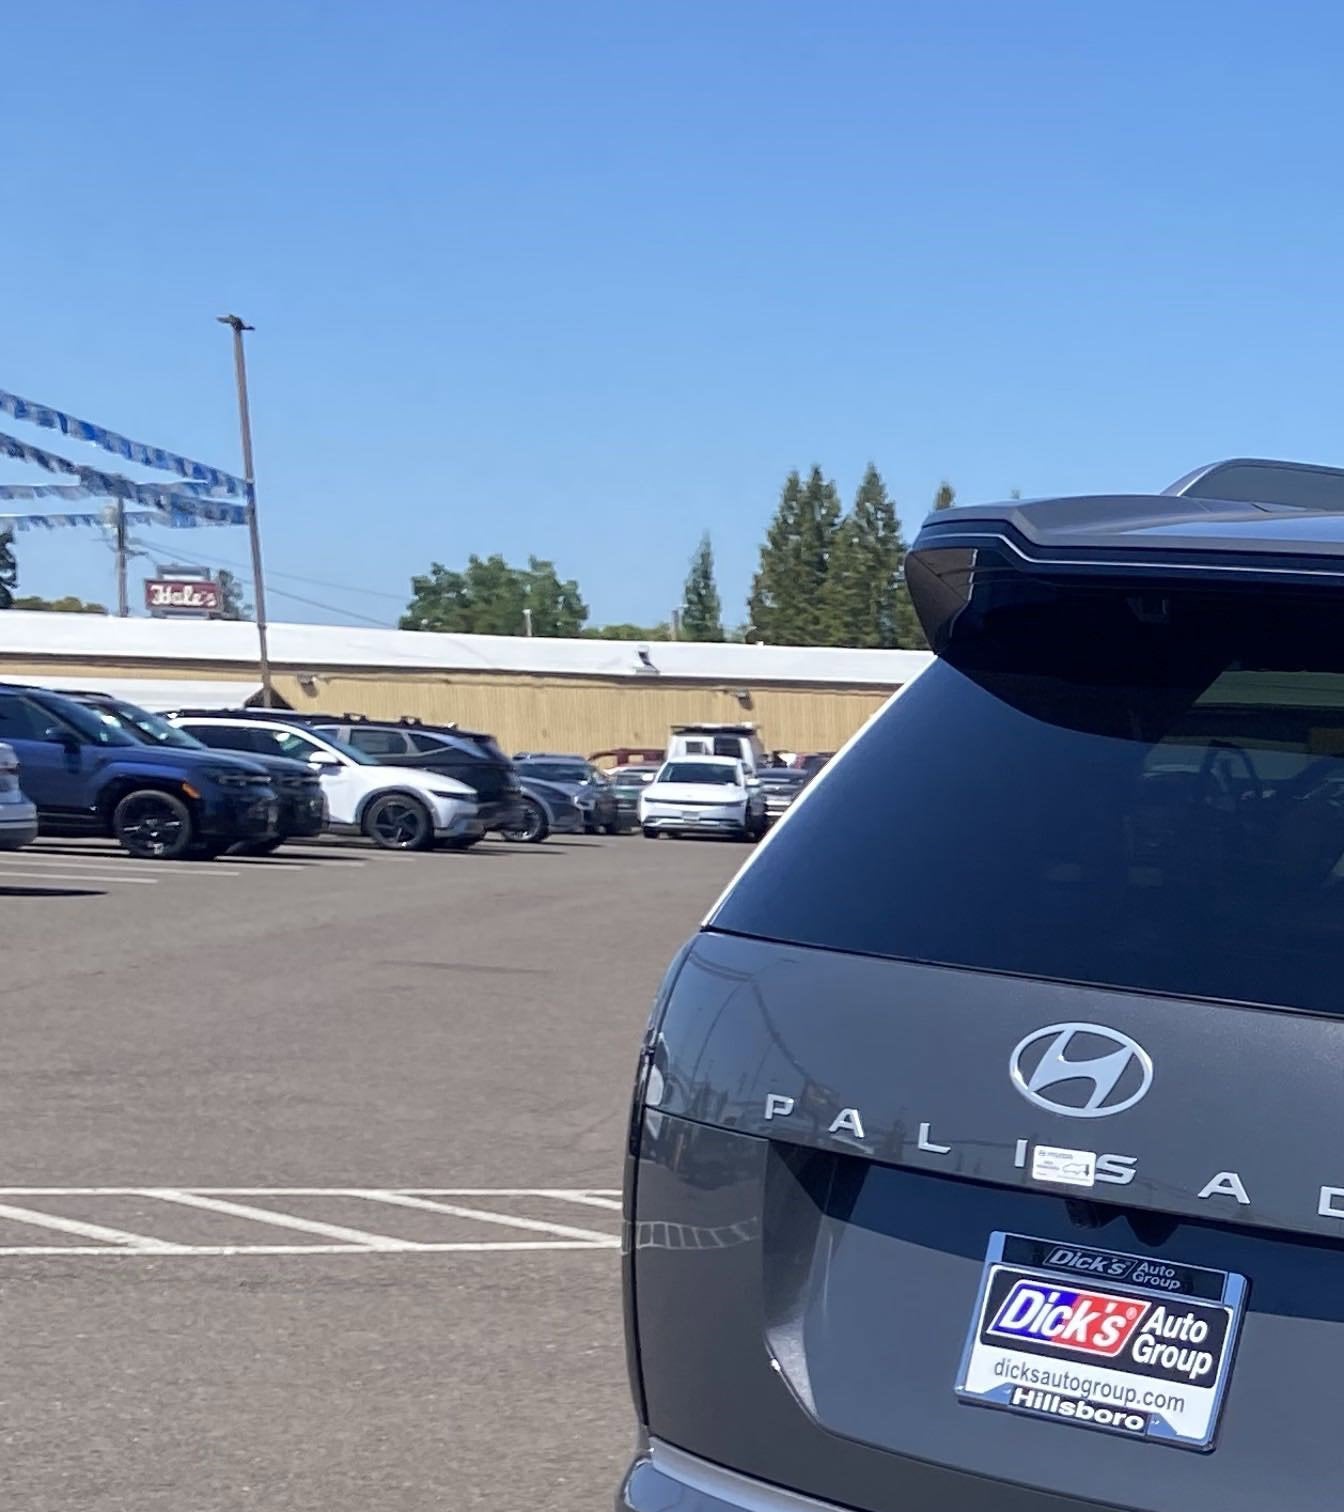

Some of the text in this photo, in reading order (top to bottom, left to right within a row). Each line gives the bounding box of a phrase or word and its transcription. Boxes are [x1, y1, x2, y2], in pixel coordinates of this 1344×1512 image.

[1049, 1249, 1176, 1278] Dick's Auto
[1132, 1271, 1181, 1290] Group
[998, 1289, 1209, 1349] Dick's Auto
[1131, 1333, 1214, 1380] Group
[994, 1358, 1185, 1413] dicksautogroup.com
[1011, 1386, 1146, 1432] Hillsboro
